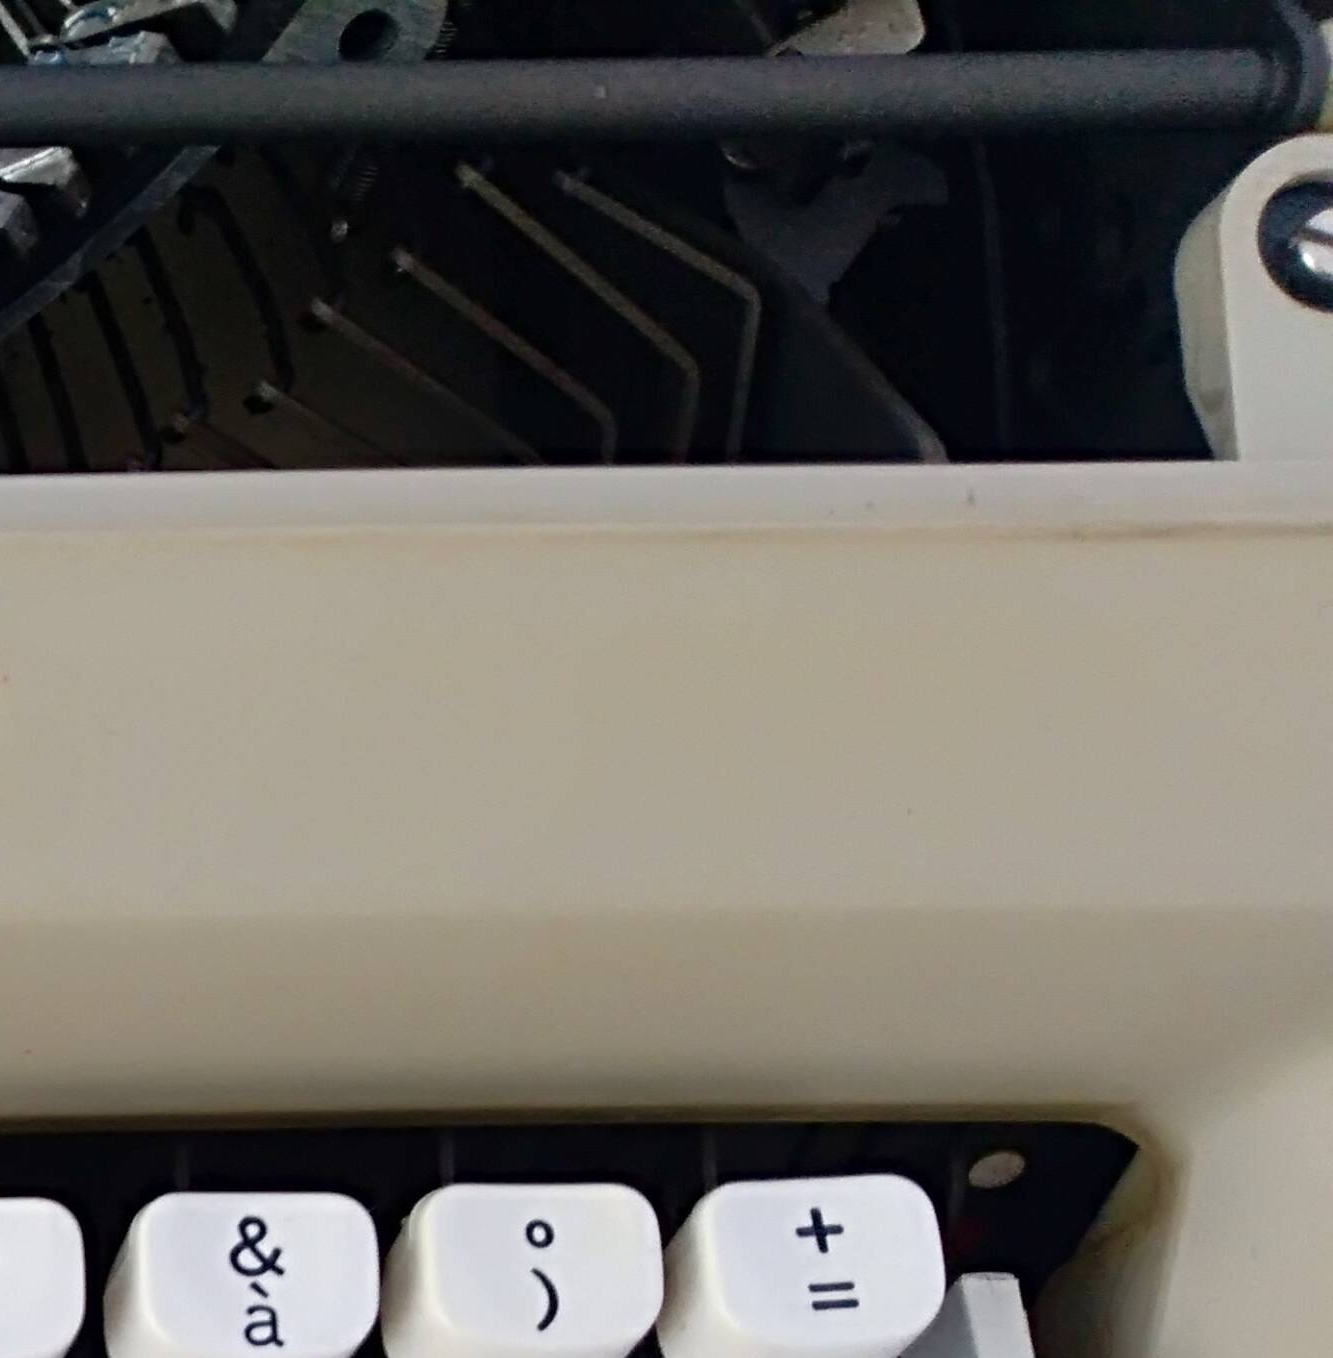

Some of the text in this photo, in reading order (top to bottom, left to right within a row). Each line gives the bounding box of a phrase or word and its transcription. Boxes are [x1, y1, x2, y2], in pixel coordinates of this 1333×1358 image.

[229, 1216, 284, 1277] &
[796, 1208, 843, 1253] +
[244, 1284, 284, 1347] à
[531, 1269, 559, 1331] )
[808, 1282, 859, 1310] =
